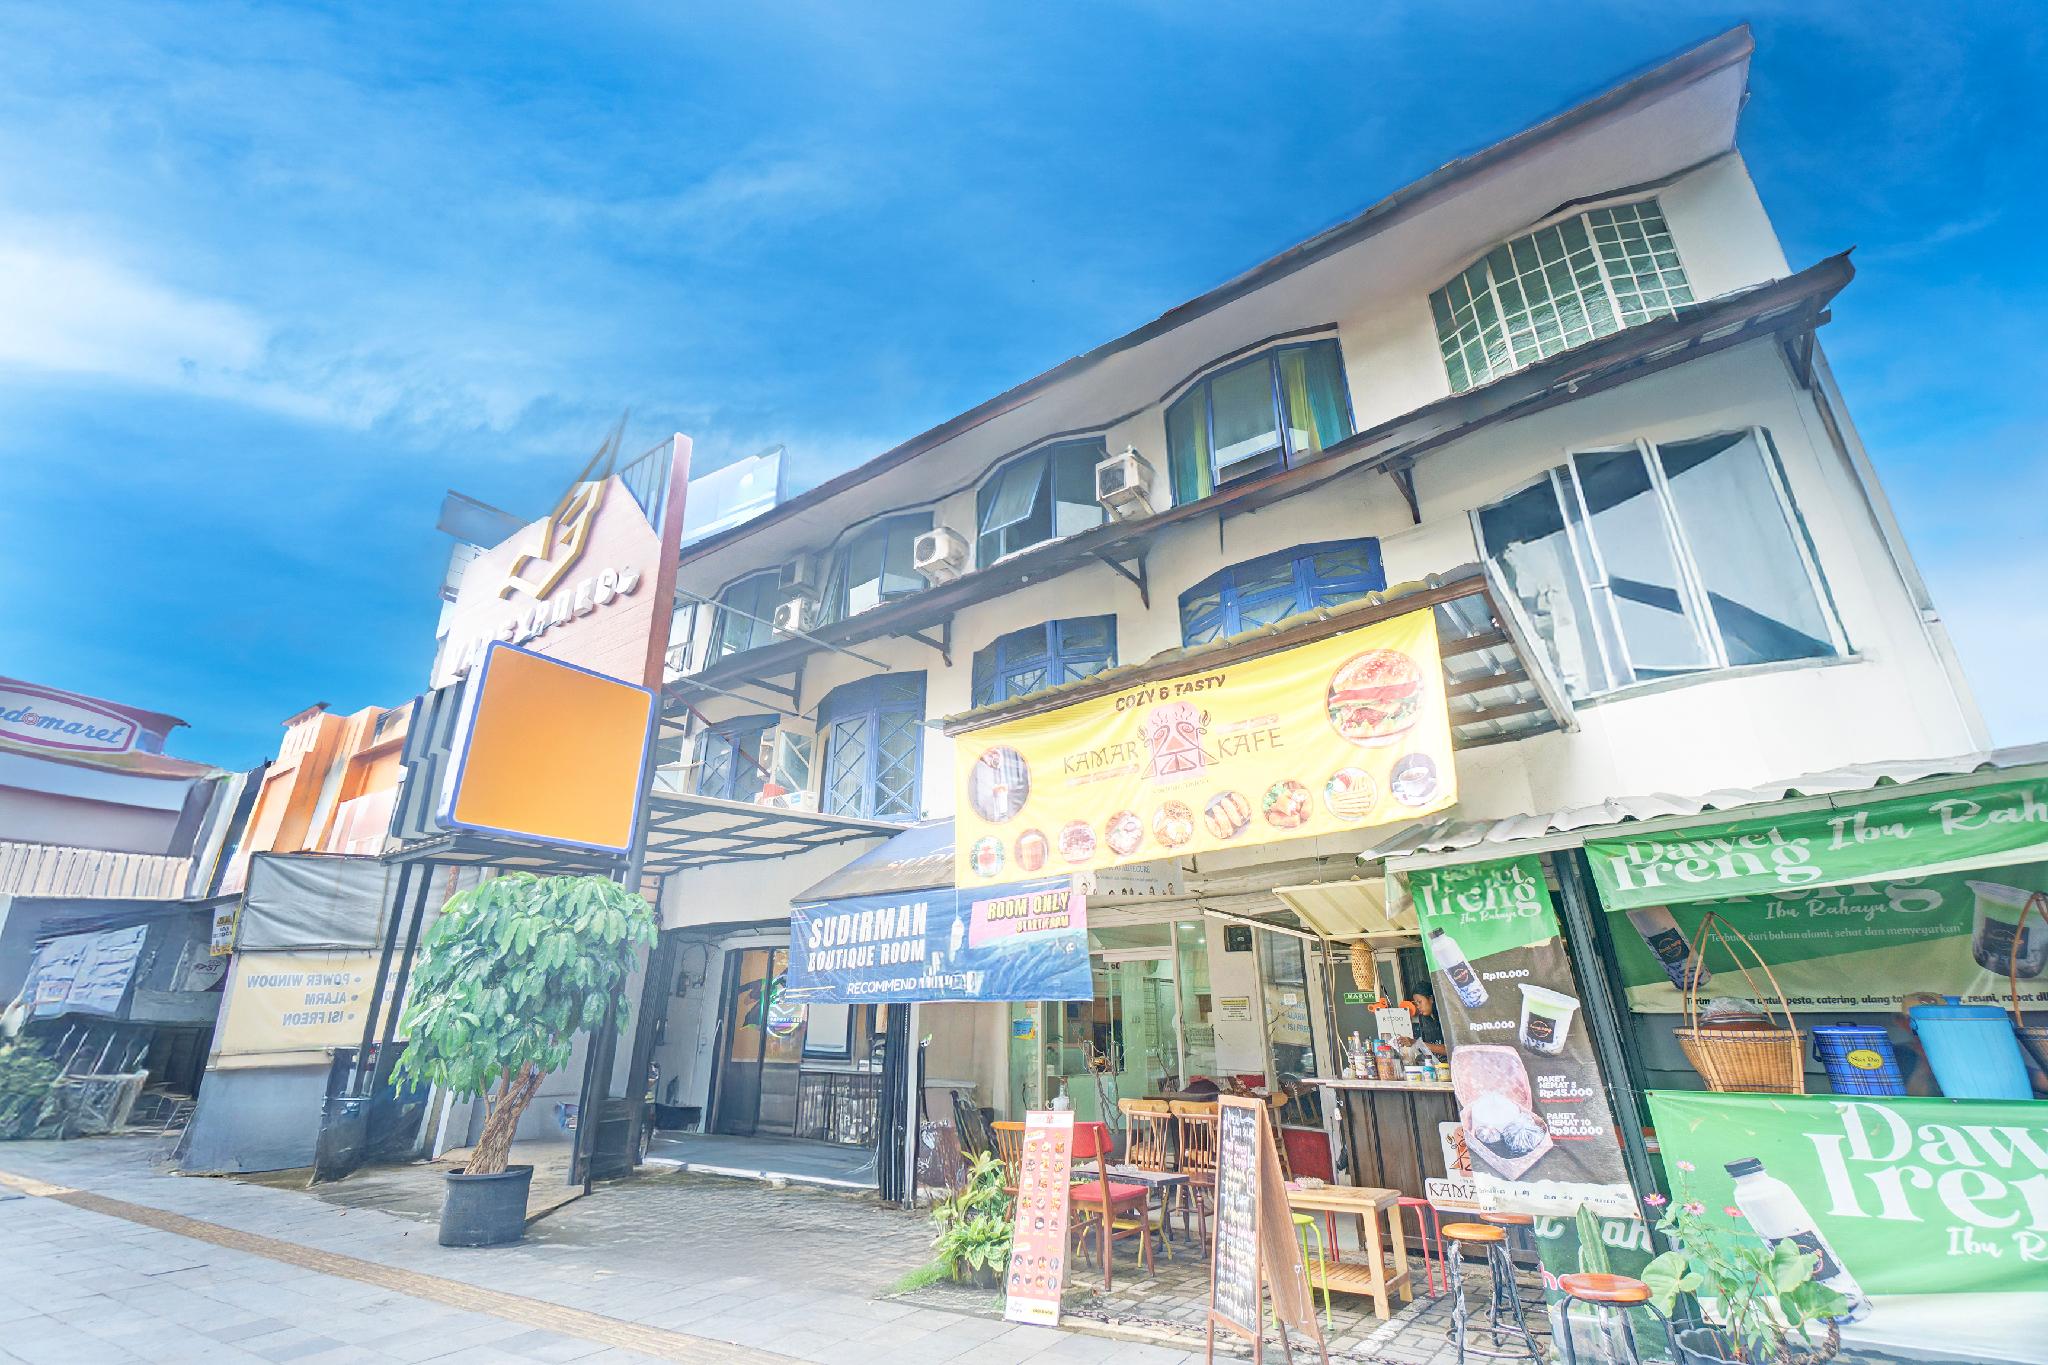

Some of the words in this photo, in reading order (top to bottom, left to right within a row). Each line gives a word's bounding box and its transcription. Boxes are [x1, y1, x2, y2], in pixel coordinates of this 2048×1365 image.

[1116, 689, 1154, 711] COZY
[1175, 675, 1225, 696] TASTY
[1064, 741, 1138, 774] KAMAR
[1217, 728, 1283, 758] KAFE
[1625, 827, 1786, 865] Dawet
[1827, 812, 1914, 850] Ibu
[1609, 838, 1822, 890] Ireng
[987, 898, 1028, 921] ROOM
[1032, 892, 1070, 915] ONLY
[1766, 900, 1799, 920] Ibu
[1805, 897, 1888, 921] Rahayu
[808, 902, 928, 948] SUDIRMAN
[1748, 932, 1767, 941] dari
[1769, 930, 1800, 940] bahan
[1801, 929, 1833, 939] alami,
[1835, 927, 1862, 938] sehat
[1864, 926, 1885, 936] dan
[807, 945, 875, 973] BOUTIQUE
[880, 939, 926, 966] ROOM
[846, 978, 917, 995] RECOMMEND
[1483, 969, 1530, 981] Rp10.000
[1787, 997, 1815, 1005] pesta,
[1817, 996, 1859, 1006] catering,
[1861, 995, 1890, 1005] ulang
[1892, 995, 1905, 1005] ta
[1967, 994, 2000, 1003] reuni,
[1469, 1020, 1516, 1032] Rp10.000
[1539, 1088, 1593, 1098] Rp45.000
[1550, 1126, 1603, 1136] Rp90.000
[1946, 1226, 2003, 1257] Ibu
